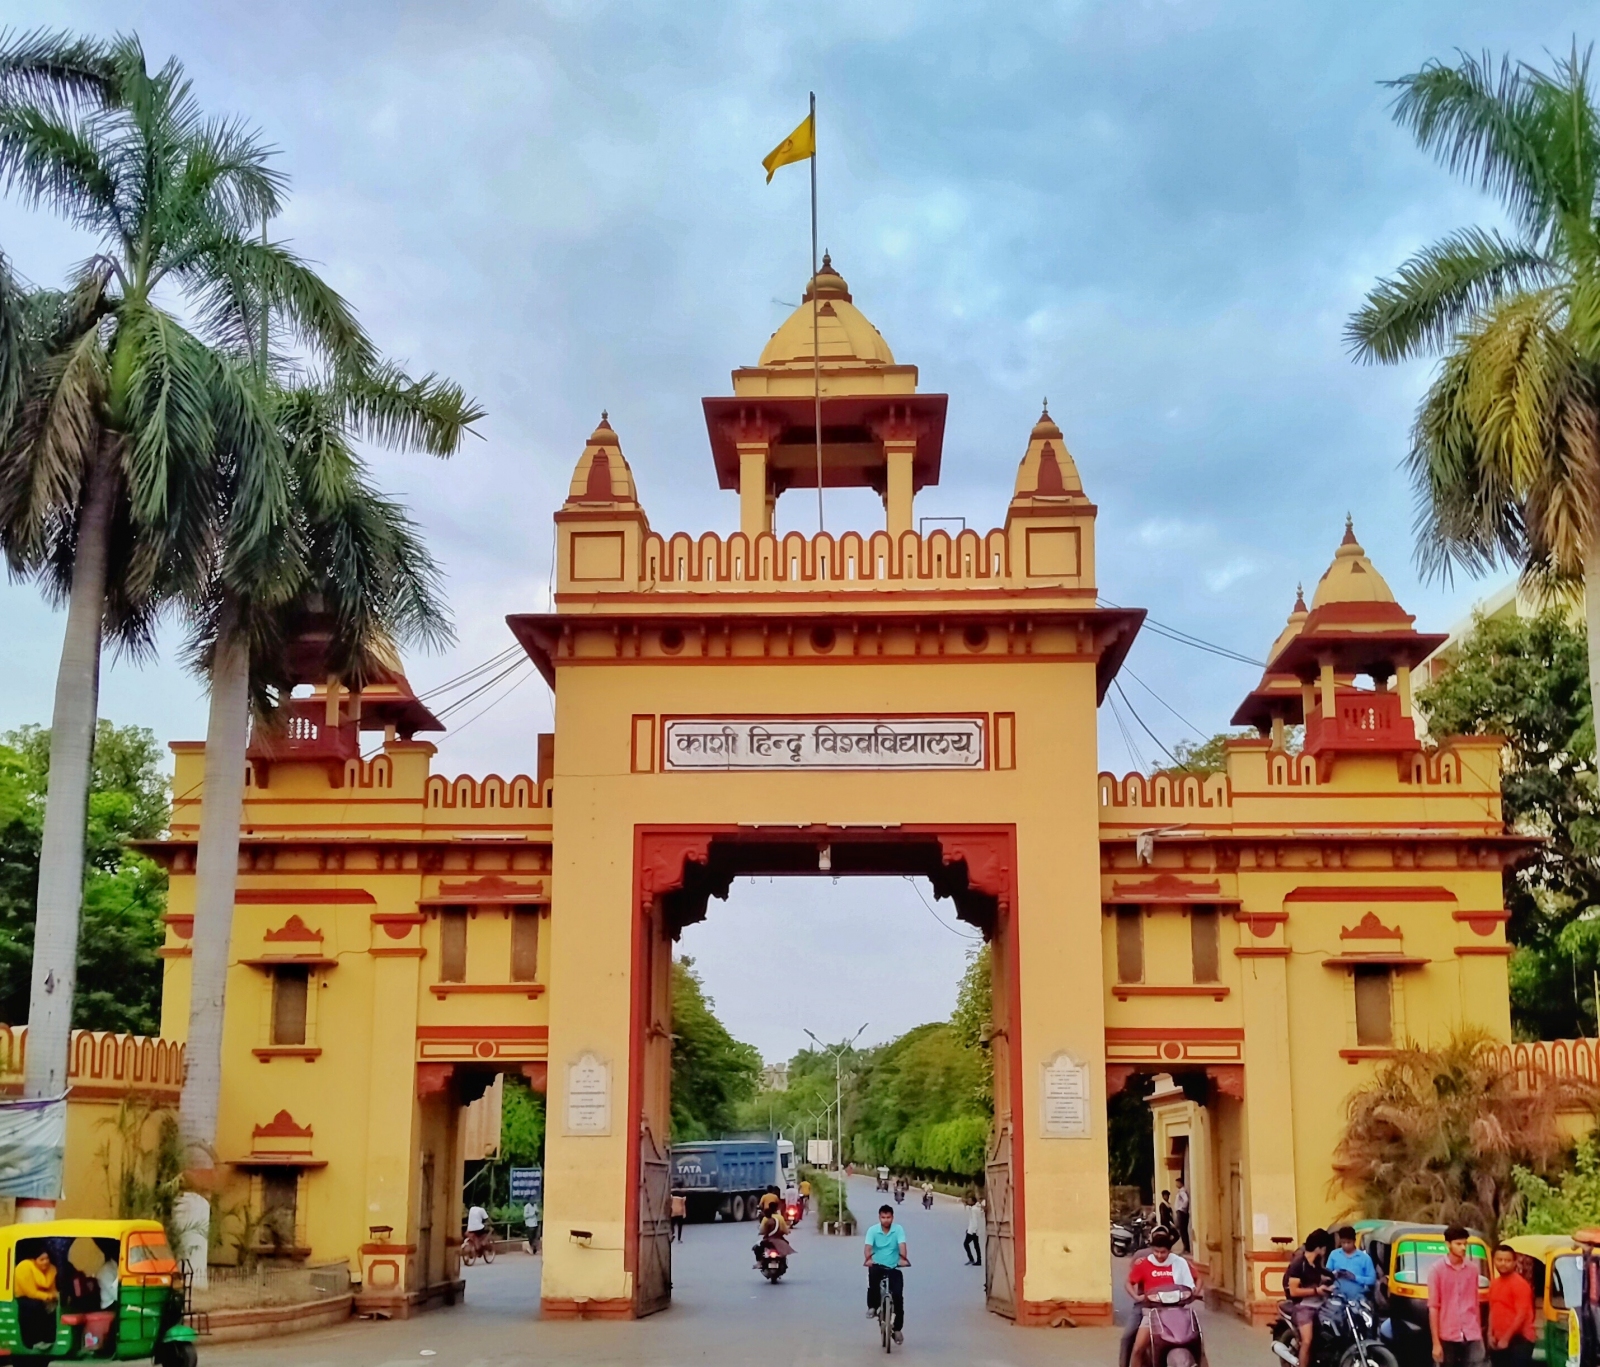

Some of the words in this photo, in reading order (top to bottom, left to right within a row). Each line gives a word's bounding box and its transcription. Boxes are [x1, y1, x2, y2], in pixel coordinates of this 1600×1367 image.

[675, 725, 739, 756] काशी
[747, 725, 806, 762] हिन्दू
[812, 724, 974, 755] विश्वविद्यालय
[677, 1165, 702, 1174] TATA
